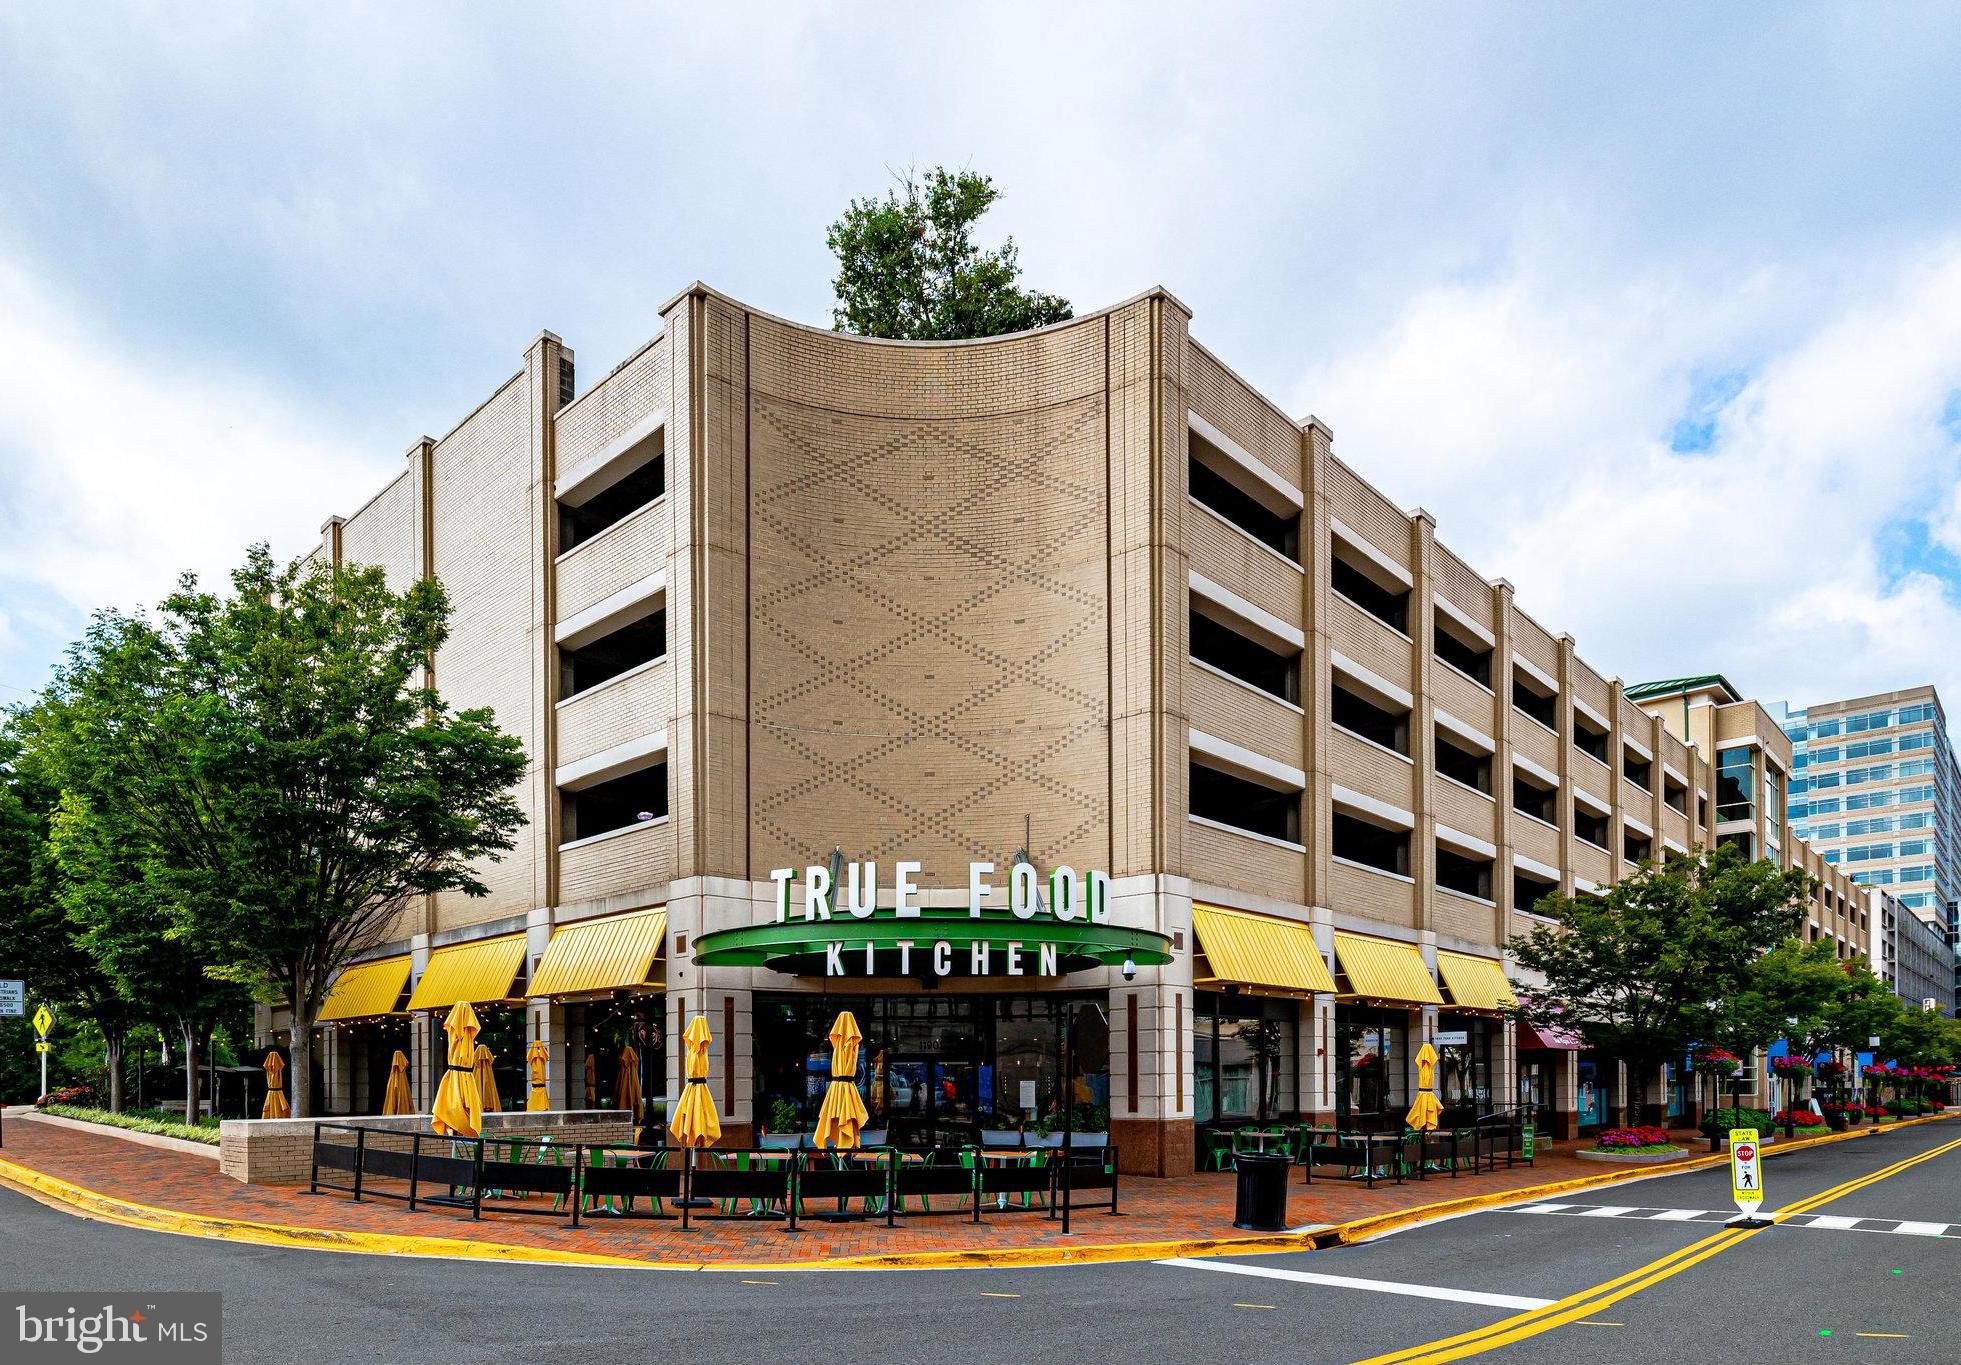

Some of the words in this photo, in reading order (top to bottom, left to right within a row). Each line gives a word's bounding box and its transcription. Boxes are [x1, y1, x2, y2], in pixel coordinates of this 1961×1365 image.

[770, 862, 922, 923] TRUE
[969, 862, 1112, 924] FOOD
[826, 940, 1058, 977] KITCHEN
